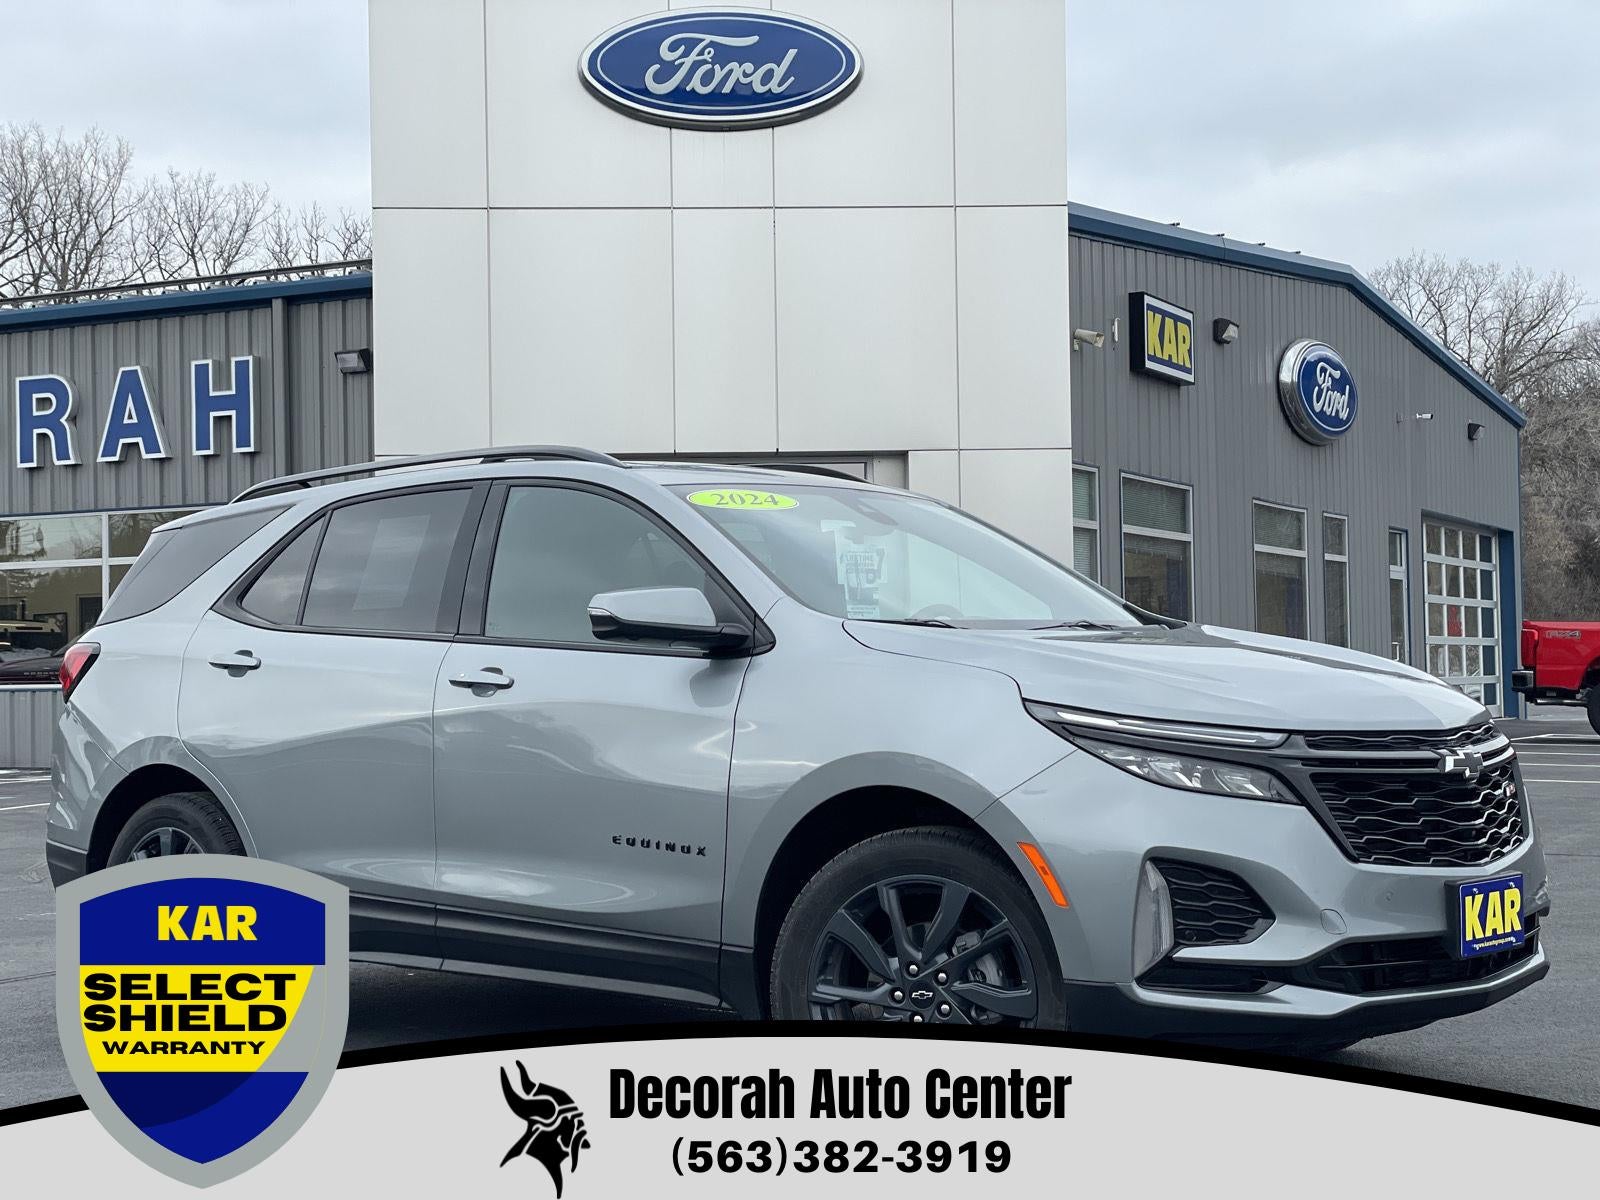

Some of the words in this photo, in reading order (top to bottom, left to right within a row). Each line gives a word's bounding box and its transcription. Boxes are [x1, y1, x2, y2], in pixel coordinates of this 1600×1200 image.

[644, 32, 798, 95] Ford
[1147, 310, 1192, 368] KAR
[15, 354, 260, 468] RAH
[1312, 361, 1350, 421] Ford
[710, 493, 779, 506] 2024
[611, 834, 706, 857] EQUINOX
[1464, 887, 1522, 941] KAR
